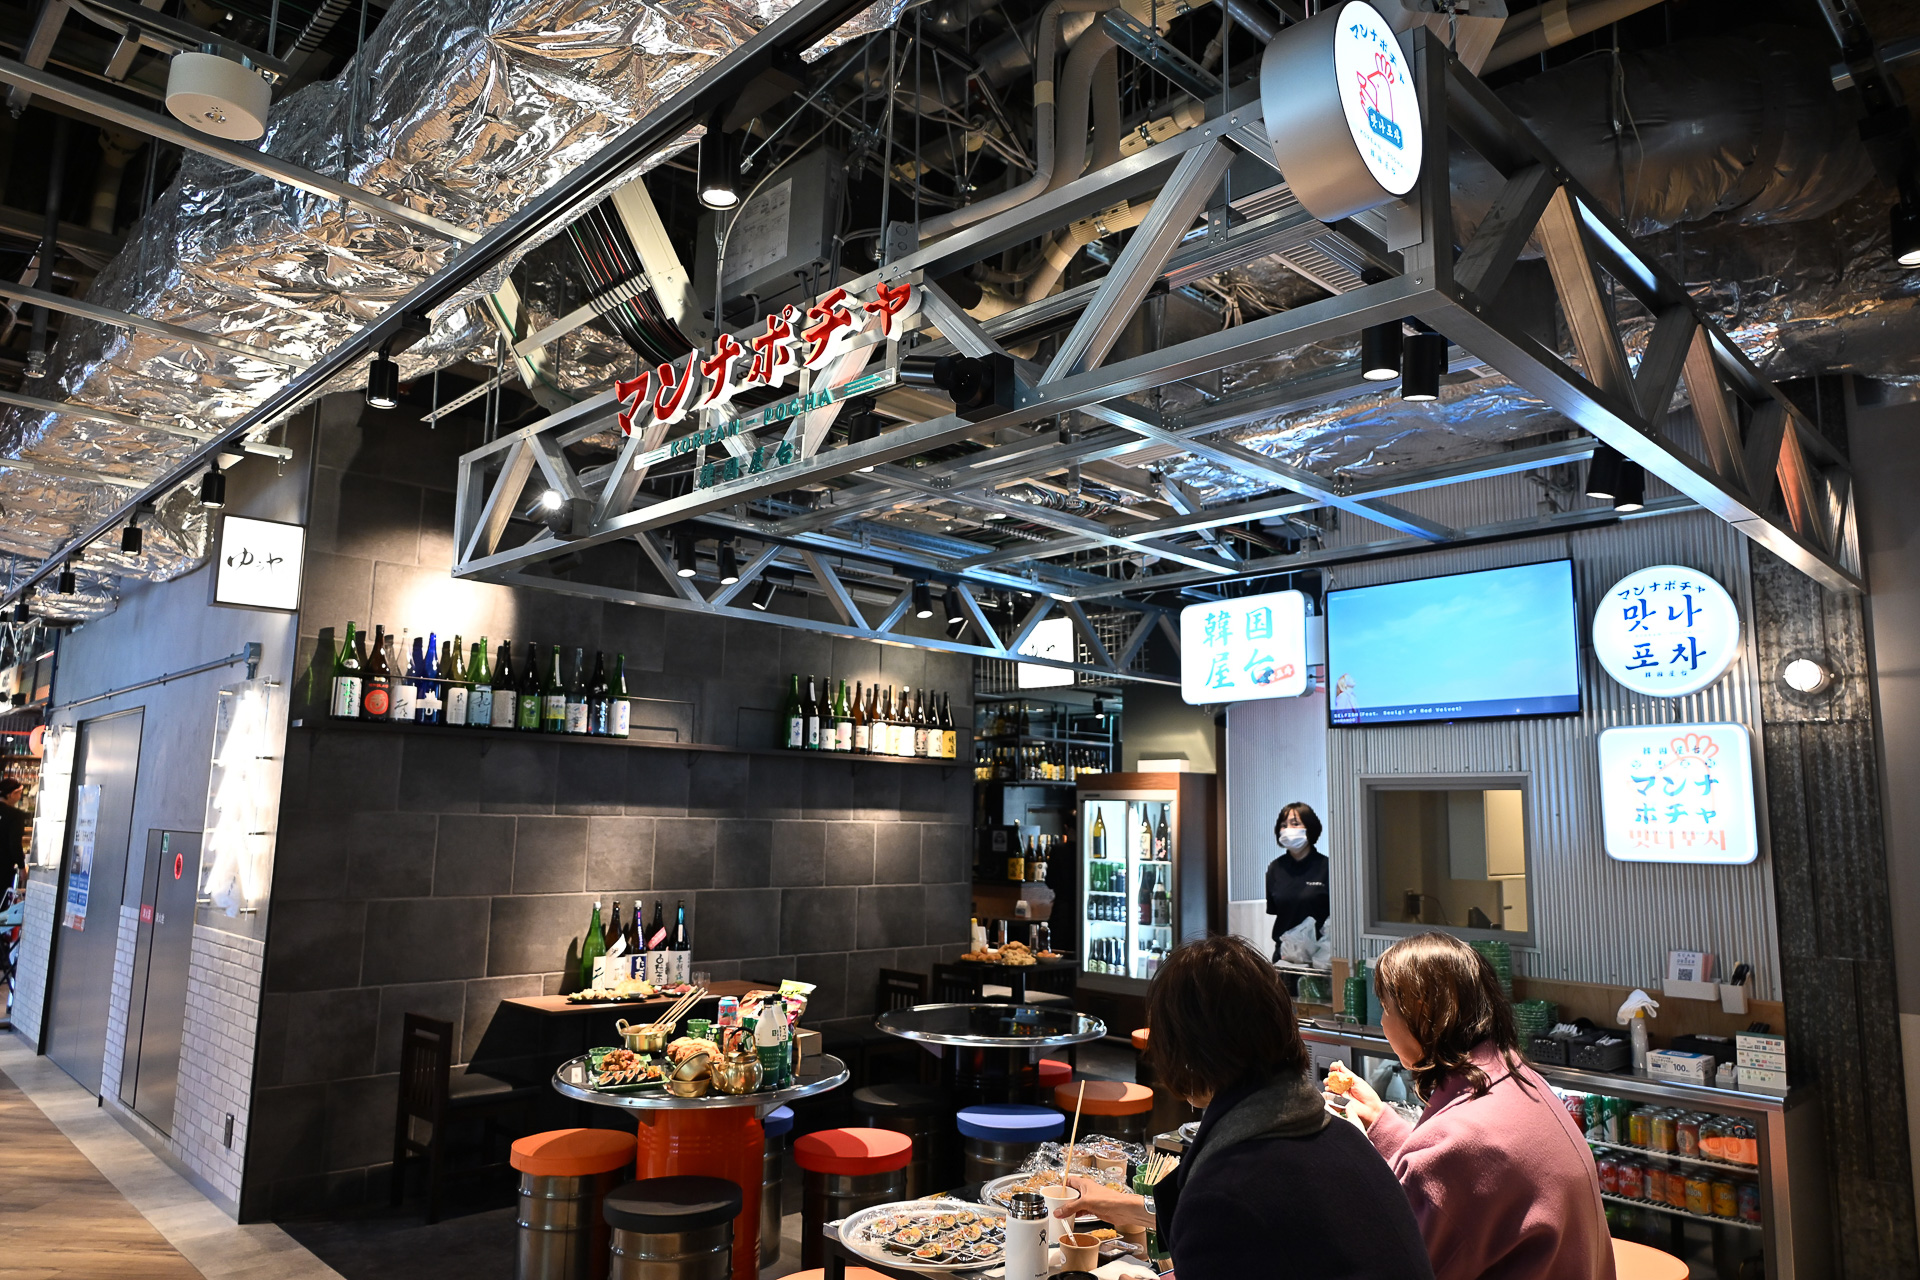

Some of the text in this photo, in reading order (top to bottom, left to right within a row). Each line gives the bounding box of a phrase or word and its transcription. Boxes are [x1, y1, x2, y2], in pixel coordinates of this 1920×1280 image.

[614, 281, 913, 437] マンナポチャ
[669, 424, 740, 457] KOREAN
[763, 386, 834, 426] POCHA
[698, 440, 794, 490] 韓国屋台
[1617, 580, 1706, 600] マンナポチャ
[1202, 606, 1274, 649] 韓国
[1622, 594, 1703, 632] 맛나
[1203, 648, 1275, 690] 屋台
[1625, 637, 1707, 671] 포차
[1630, 774, 1720, 797] マンナ
[1634, 802, 1717, 825] ポチャ
[1673, 1063, 1687, 1072] 100
